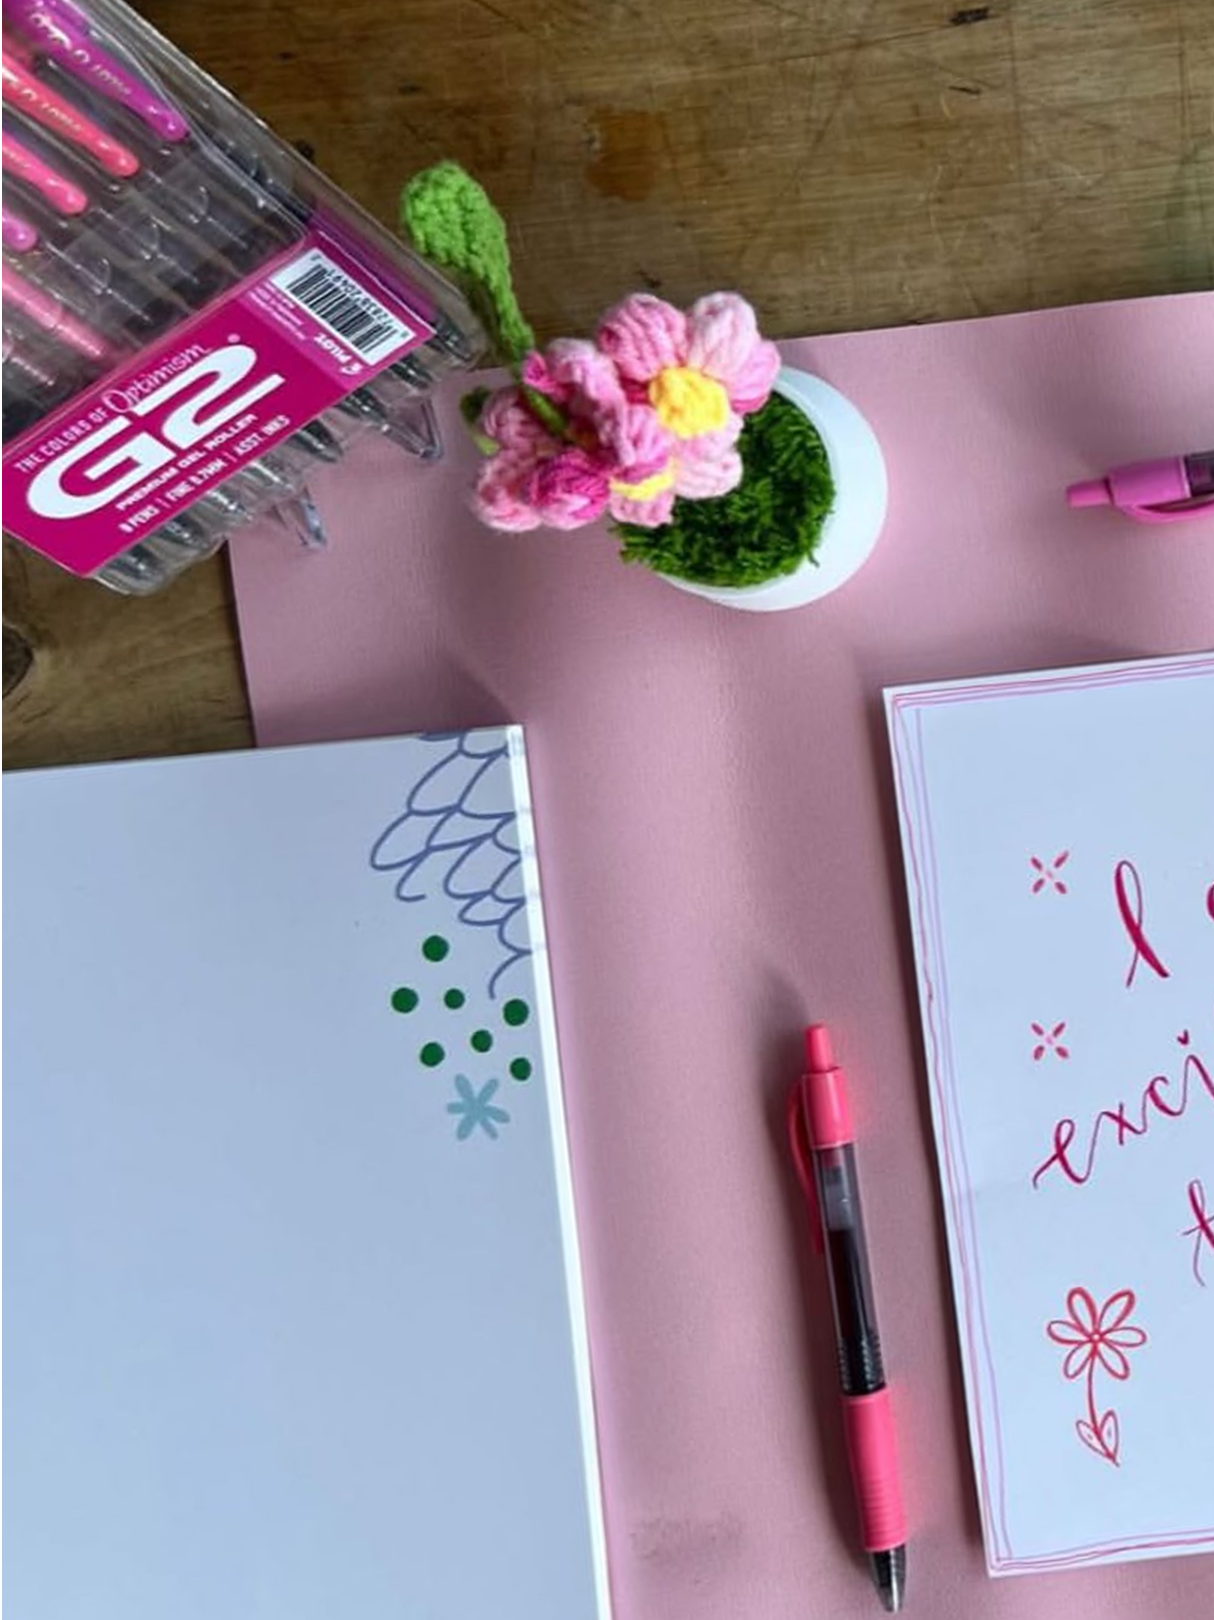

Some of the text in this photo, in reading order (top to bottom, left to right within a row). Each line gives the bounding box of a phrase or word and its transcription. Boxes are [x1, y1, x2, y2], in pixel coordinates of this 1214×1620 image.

[313, 332, 353, 363] PILOT
[13, 343, 211, 474] THE COLORS OF Optimism
[26, 343, 286, 520] G2
[116, 414, 257, 510] PREMIUM GEL ROLLER
